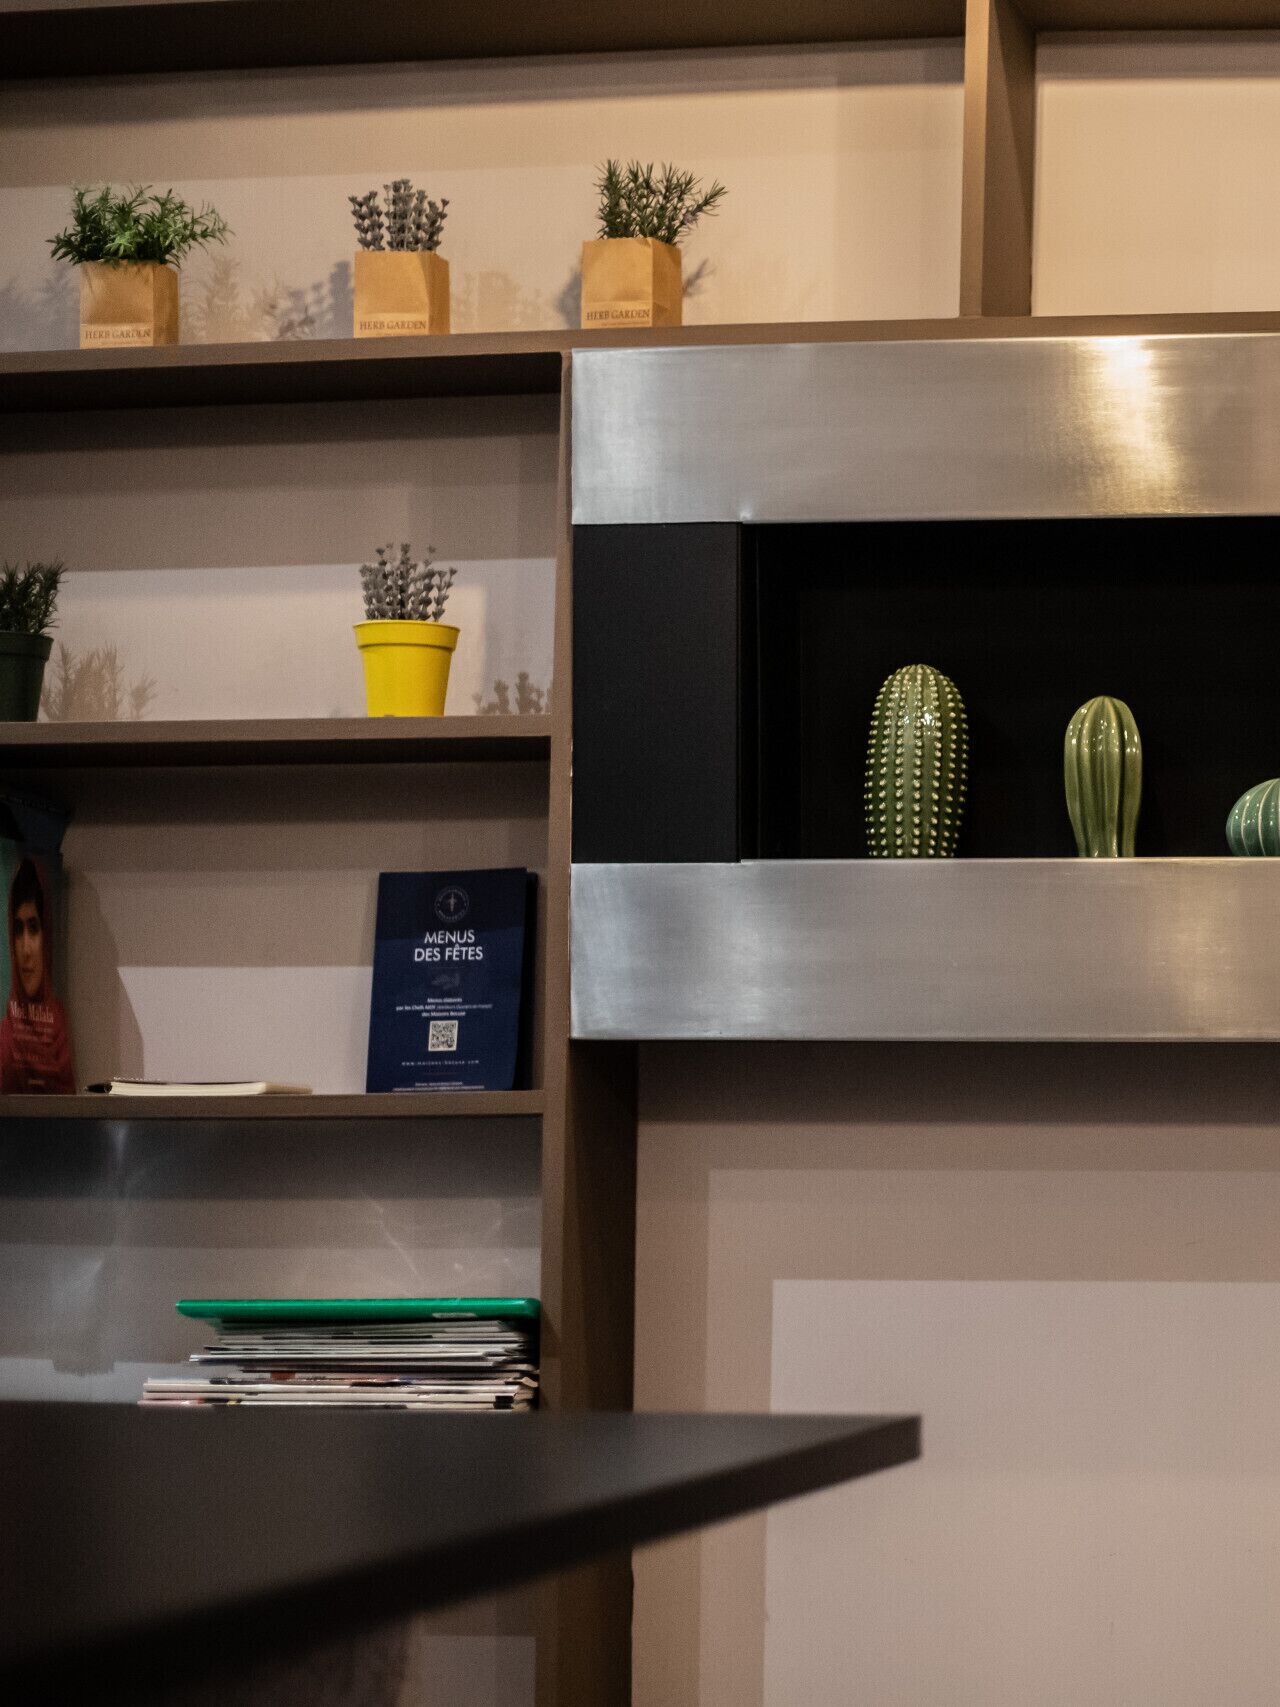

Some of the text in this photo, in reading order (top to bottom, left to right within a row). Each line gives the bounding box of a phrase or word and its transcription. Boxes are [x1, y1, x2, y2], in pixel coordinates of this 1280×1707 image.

[586, 309, 650, 320] HERB GARDEN
[359, 320, 427, 330] HERB GARDEN
[85, 328, 151, 339] HERB GARDEN
[424, 929, 475, 944] MENUS
[414, 943, 483, 962] DES FÊTES
